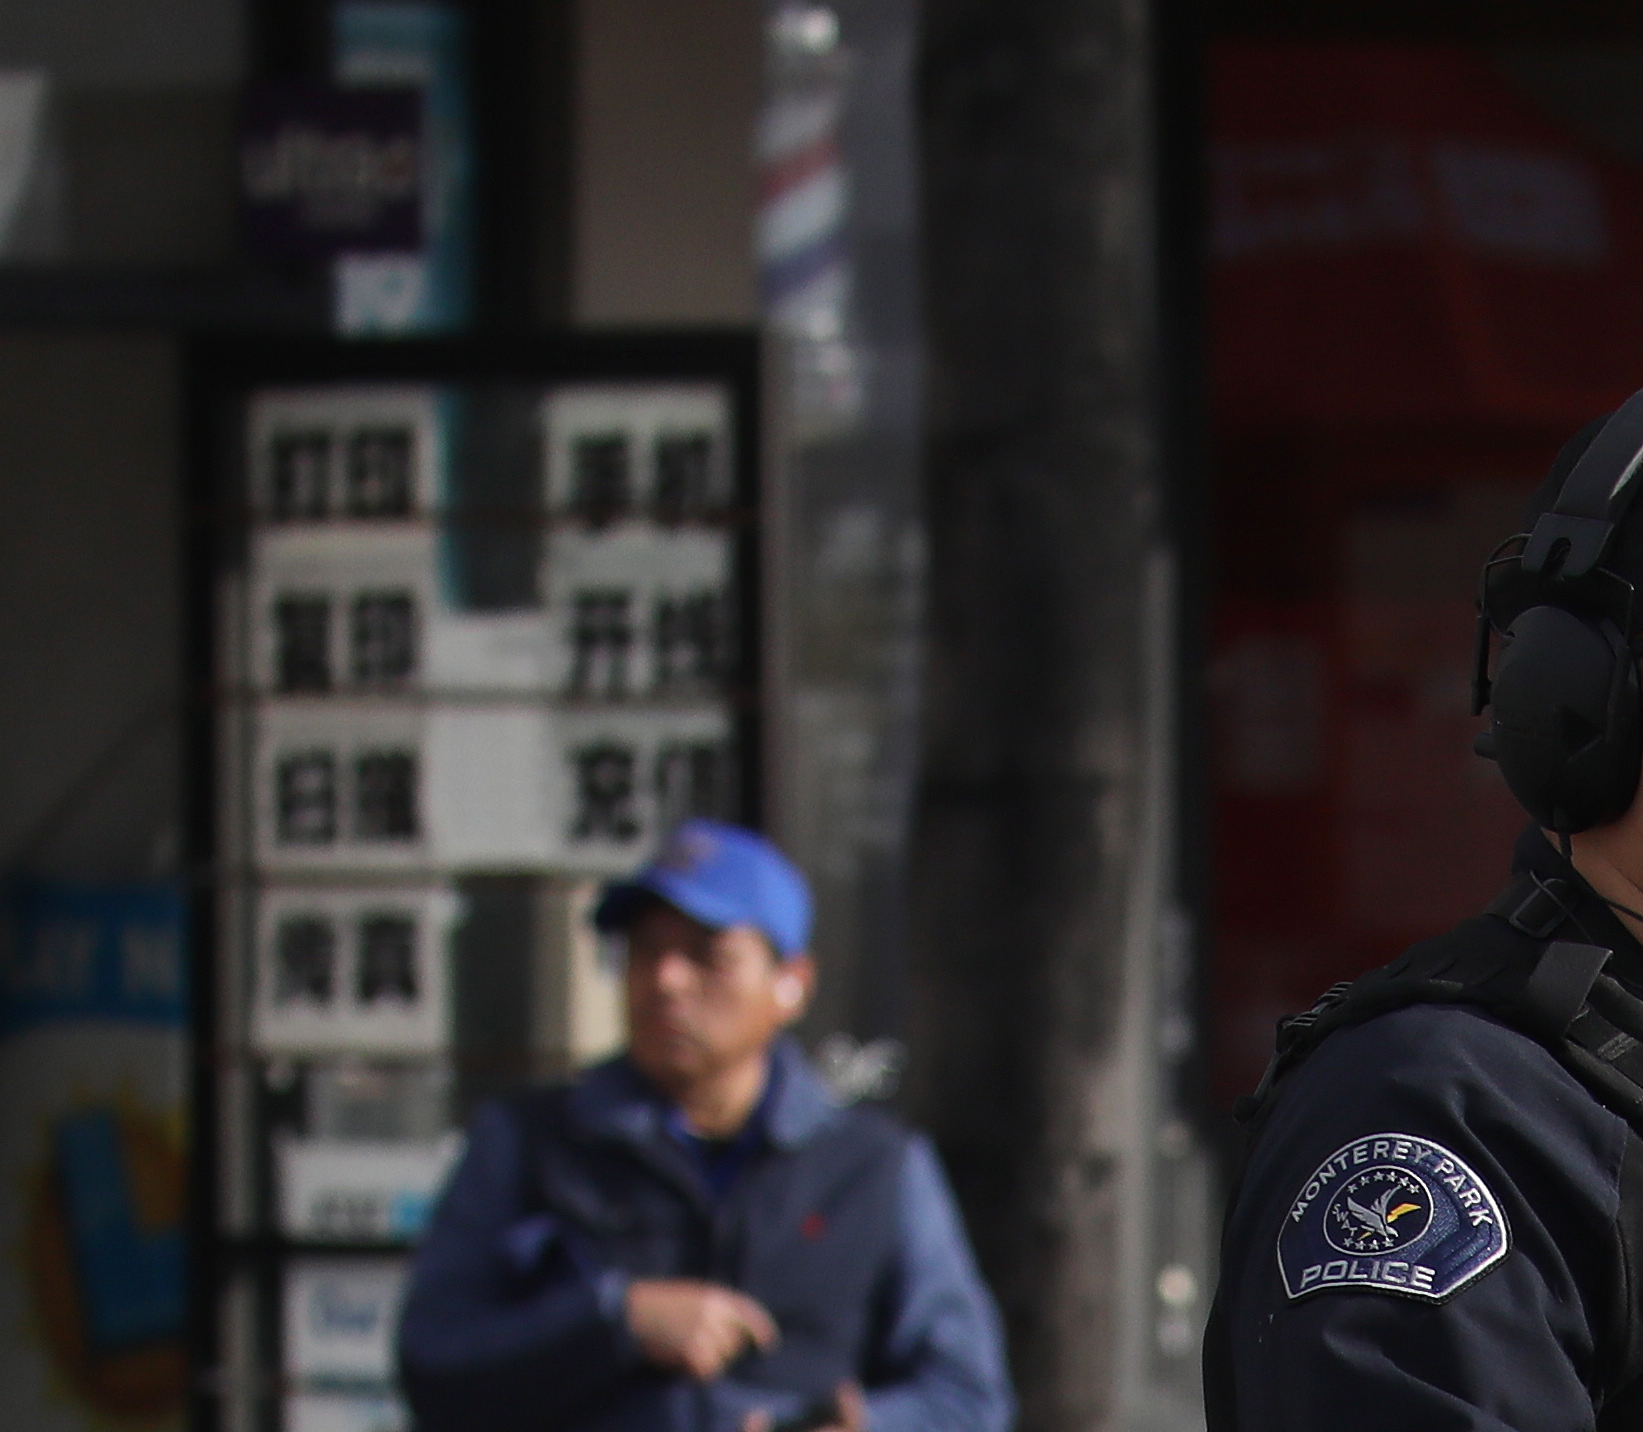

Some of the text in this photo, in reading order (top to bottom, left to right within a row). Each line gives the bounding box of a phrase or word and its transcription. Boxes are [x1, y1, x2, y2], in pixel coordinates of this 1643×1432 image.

[1291, 1139, 1494, 1228] MONTEREY PARK
[1331, 1203, 1359, 1237] SWAT
[1299, 1259, 1436, 1291] POLICE
